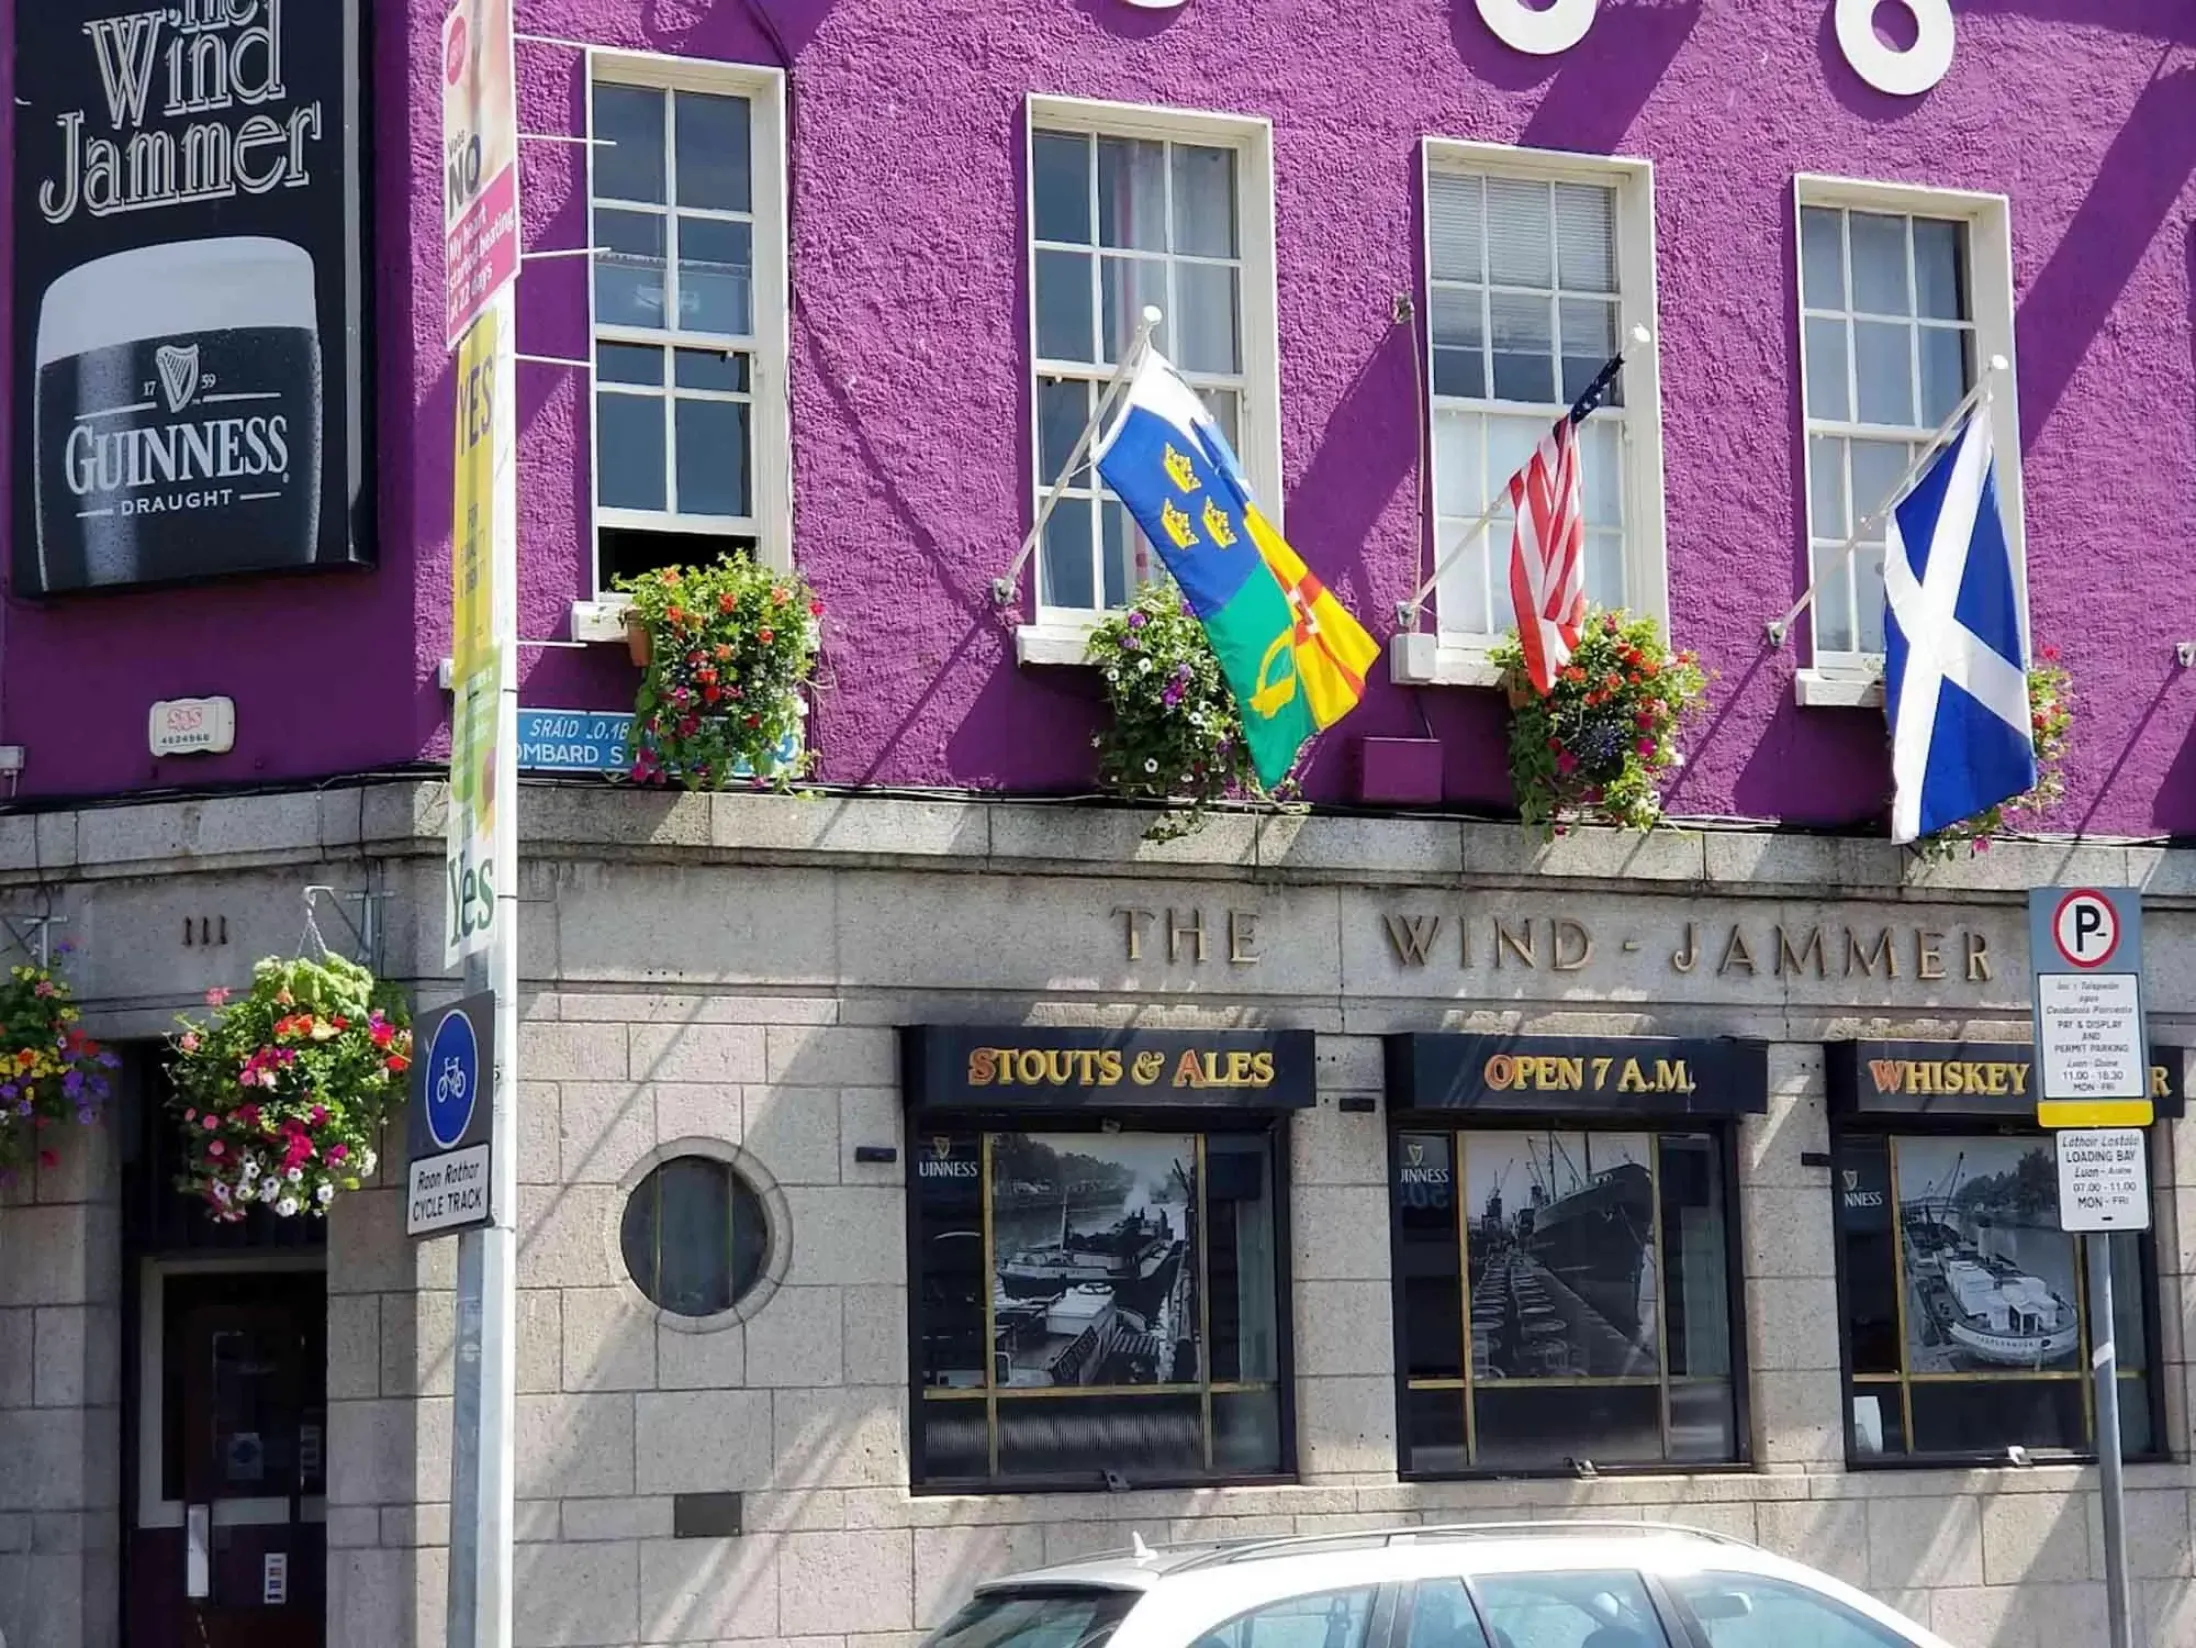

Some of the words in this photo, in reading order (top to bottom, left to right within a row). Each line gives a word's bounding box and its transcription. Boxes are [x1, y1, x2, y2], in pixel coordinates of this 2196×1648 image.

[82, 0, 286, 131] Wind
[39, 100, 322, 224] Jammer
[449, 134, 481, 220] NO
[144, 380, 156, 396] 17
[201, 373, 216, 389] 59
[460, 354, 493, 457] YES
[65, 415, 288, 495] GUINNESS
[121, 488, 233, 516] DRAUGHT
[530, 715, 580, 739] SRÁID
[517, 744, 600, 765] OMBARD
[448, 850, 493, 947] Yes
[1110, 907, 1261, 963] THE
[2082, 1031, 2102, 1041] AND
[2086, 1020, 2122, 1029] DISPLAY
[2054, 1044, 2087, 1053] PERMIT
[2090, 1043, 2129, 1053] PARKING
[968, 1047, 1123, 1087] STOUTS
[1131, 1051, 1164, 1086] &
[1173, 1049, 1275, 1089] ALES
[1484, 1054, 1583, 1091] OPEN
[1591, 1057, 1614, 1091] 7
[1616, 1057, 1696, 1093] A.M.
[1868, 1059, 2030, 1095] WHISKEY
[2073, 1083, 2095, 1092] MON
[919, 1160, 978, 1178] UINNESS
[2066, 1151, 2113, 1163] LOADING
[2116, 1150, 2136, 1161] BAY
[2073, 1183, 2100, 1192] 07.00
[2110, 1182, 2136, 1191] 11.00
[413, 1195, 443, 1222] CYCLE
[448, 1186, 482, 1214] TRACK
[2078, 1196, 2103, 1208] MON
[2112, 1196, 2129, 1205] FRI
